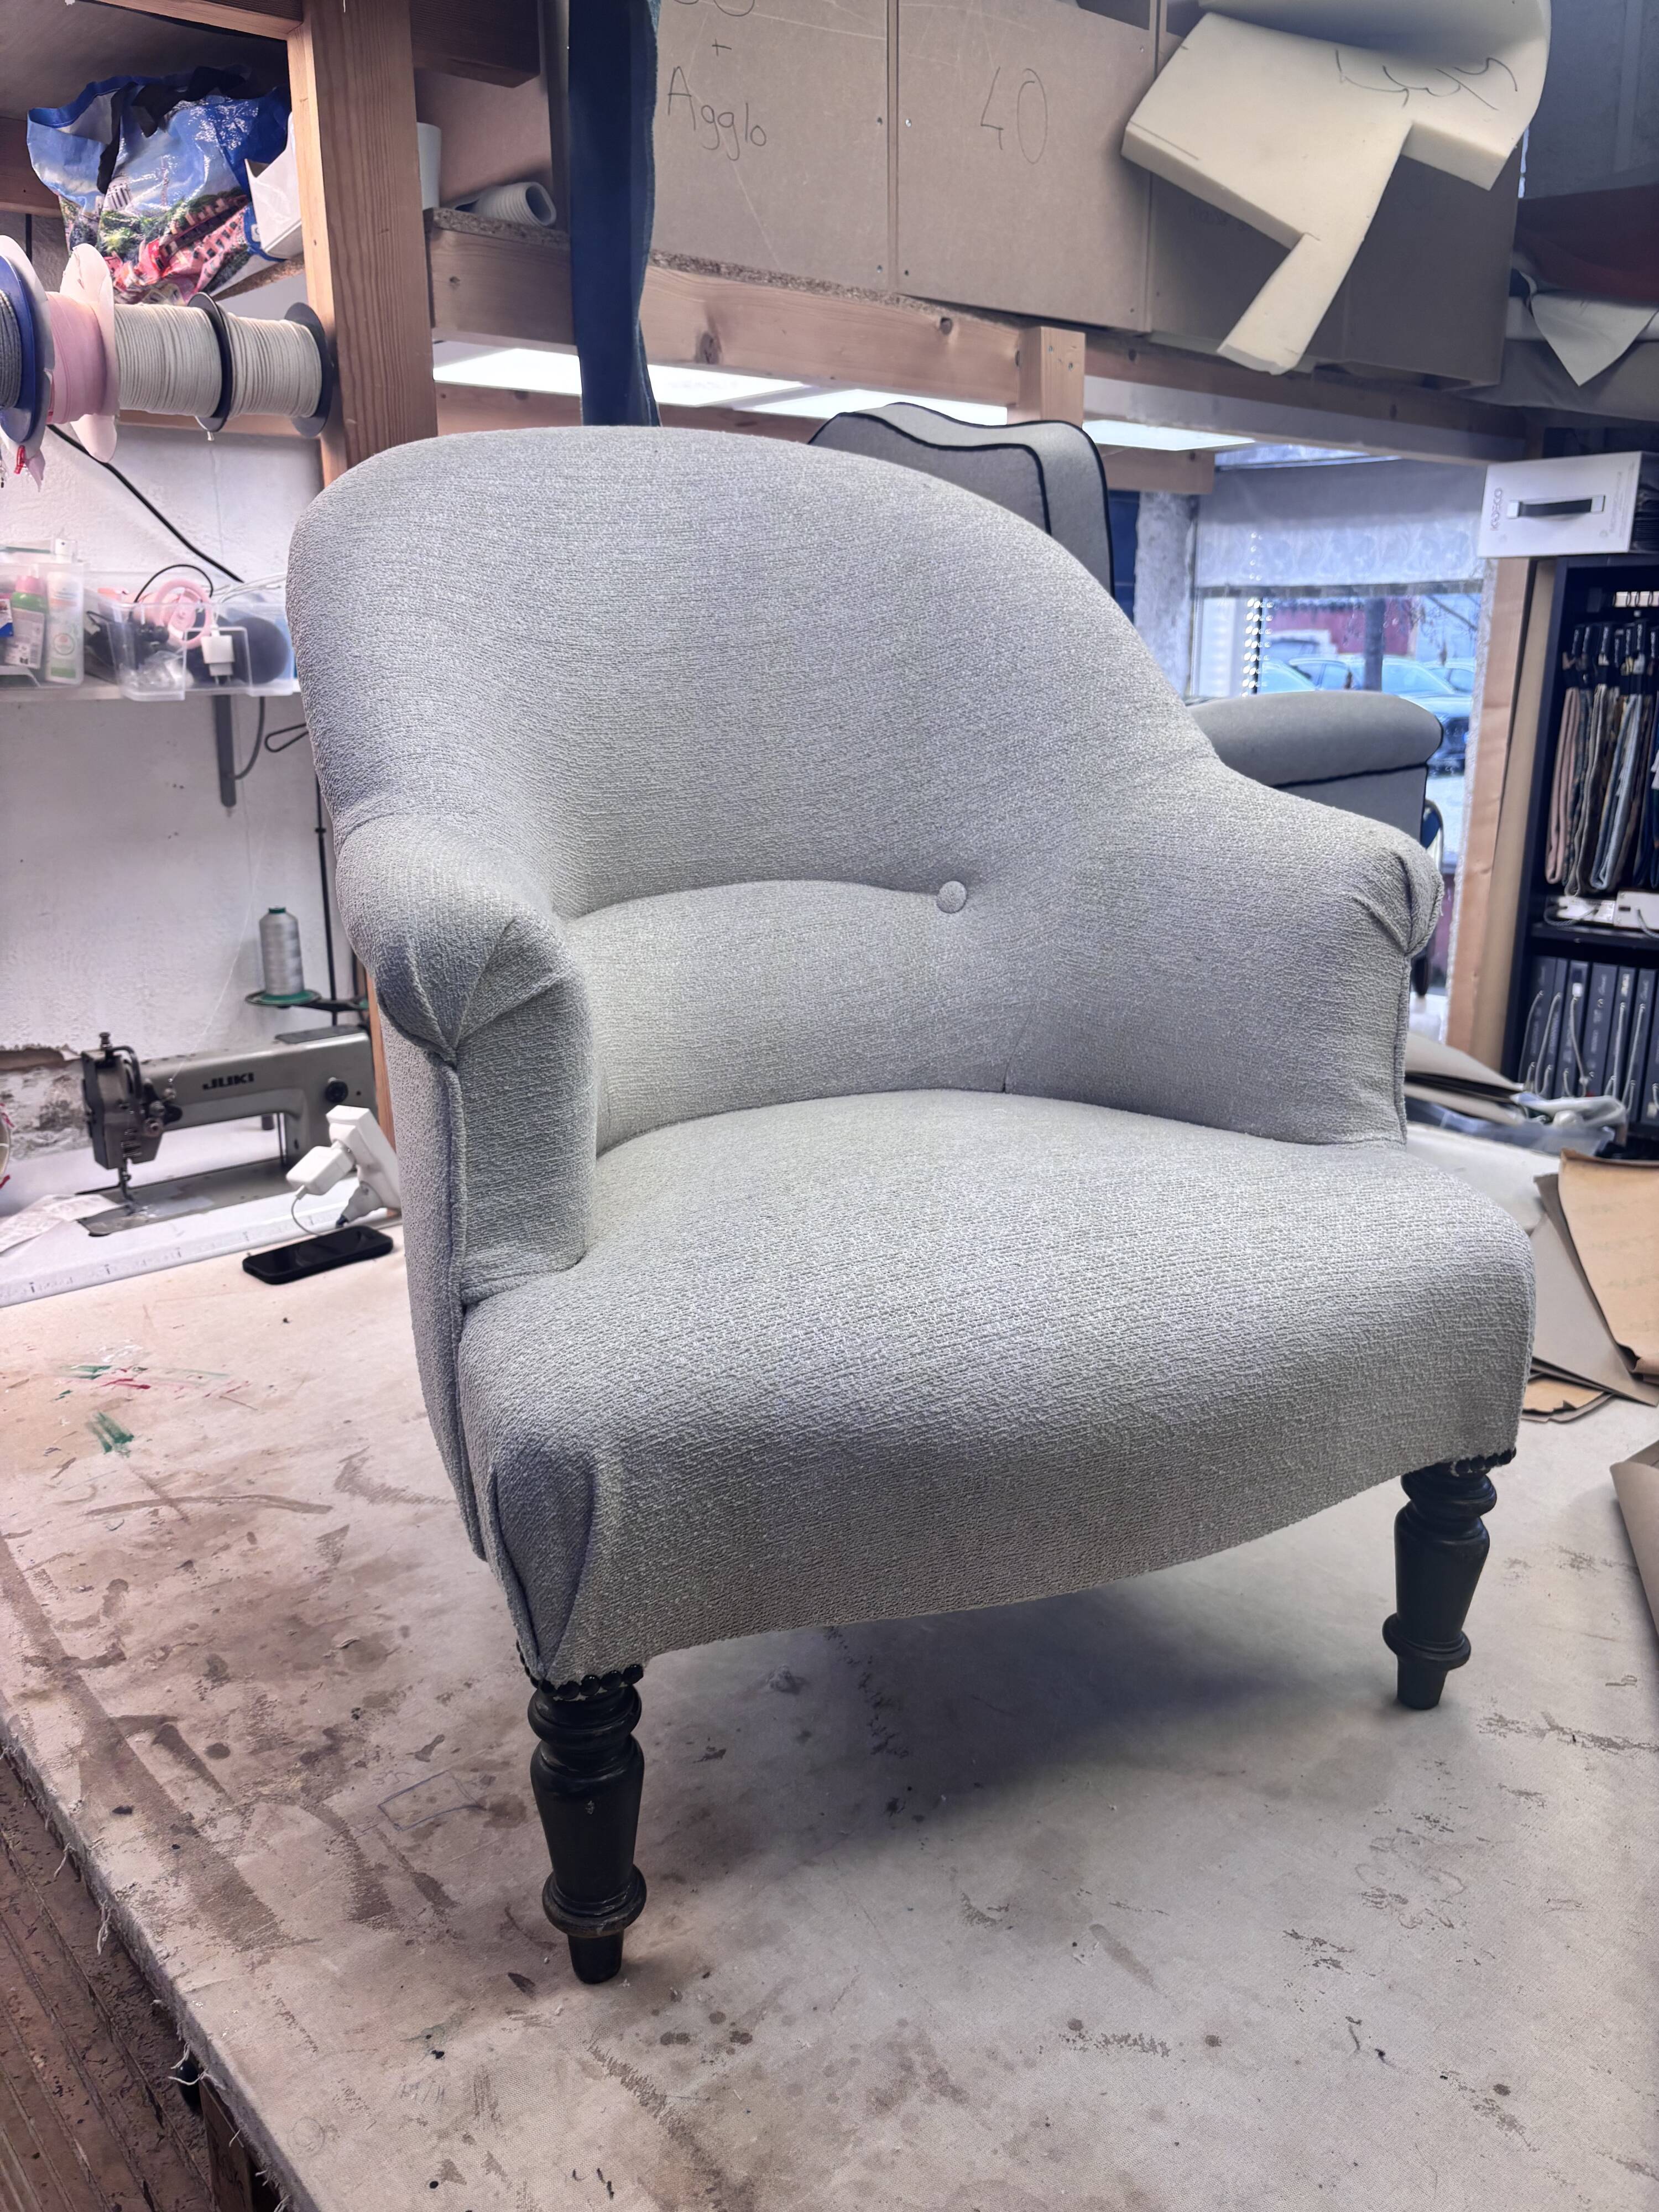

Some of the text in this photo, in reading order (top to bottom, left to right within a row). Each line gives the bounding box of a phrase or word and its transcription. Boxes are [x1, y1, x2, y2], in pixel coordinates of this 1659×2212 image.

[667, 66, 767, 161] Agglo
[980, 66, 1048, 164] 40
[202, 1072, 254, 1091] JUKI
